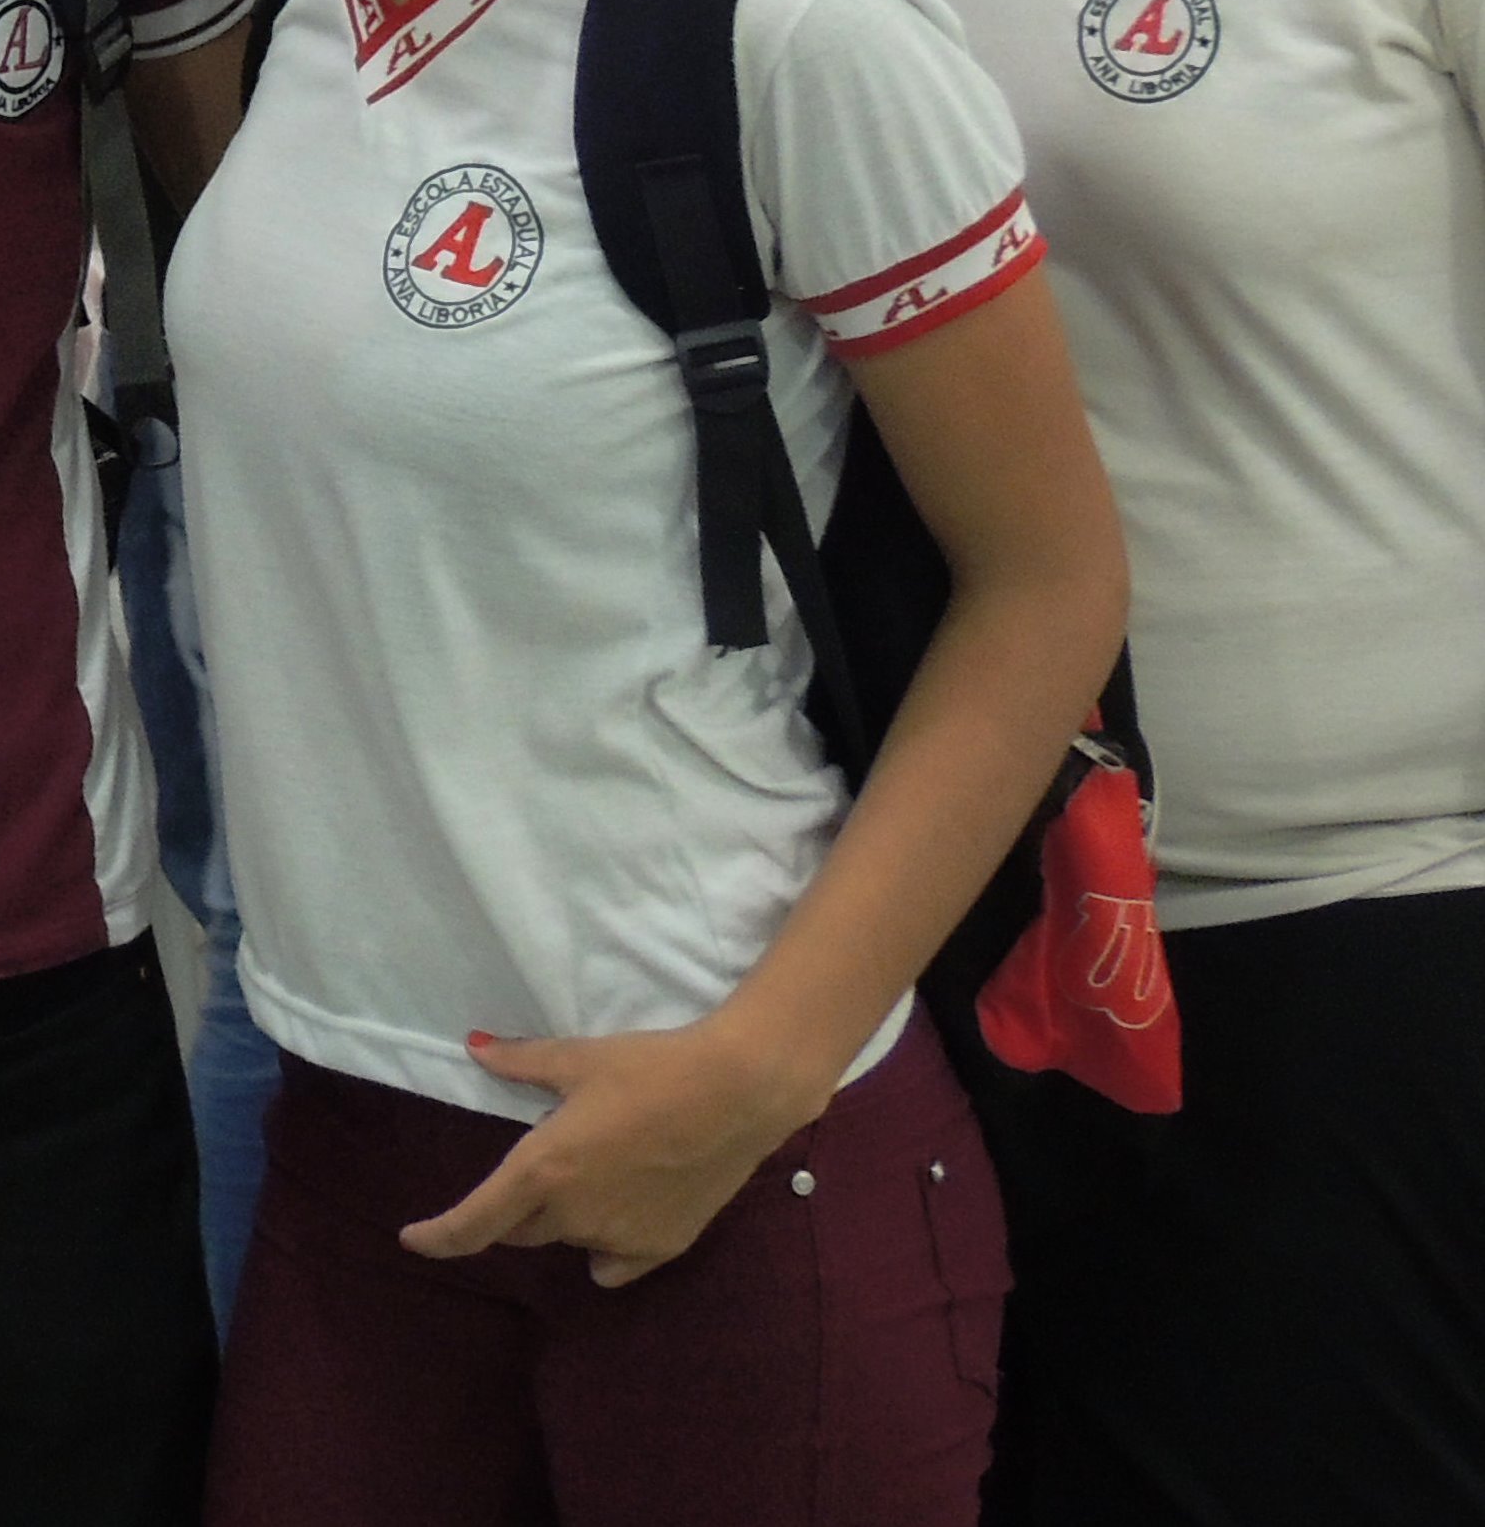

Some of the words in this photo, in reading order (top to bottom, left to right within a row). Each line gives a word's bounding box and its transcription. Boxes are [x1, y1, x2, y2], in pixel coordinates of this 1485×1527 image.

[1088, 55, 1121, 86] ANA
[396, 170, 474, 238] ESCOLA
[479, 172, 539, 273] ESTADUAL
[387, 266, 417, 310] ANA
